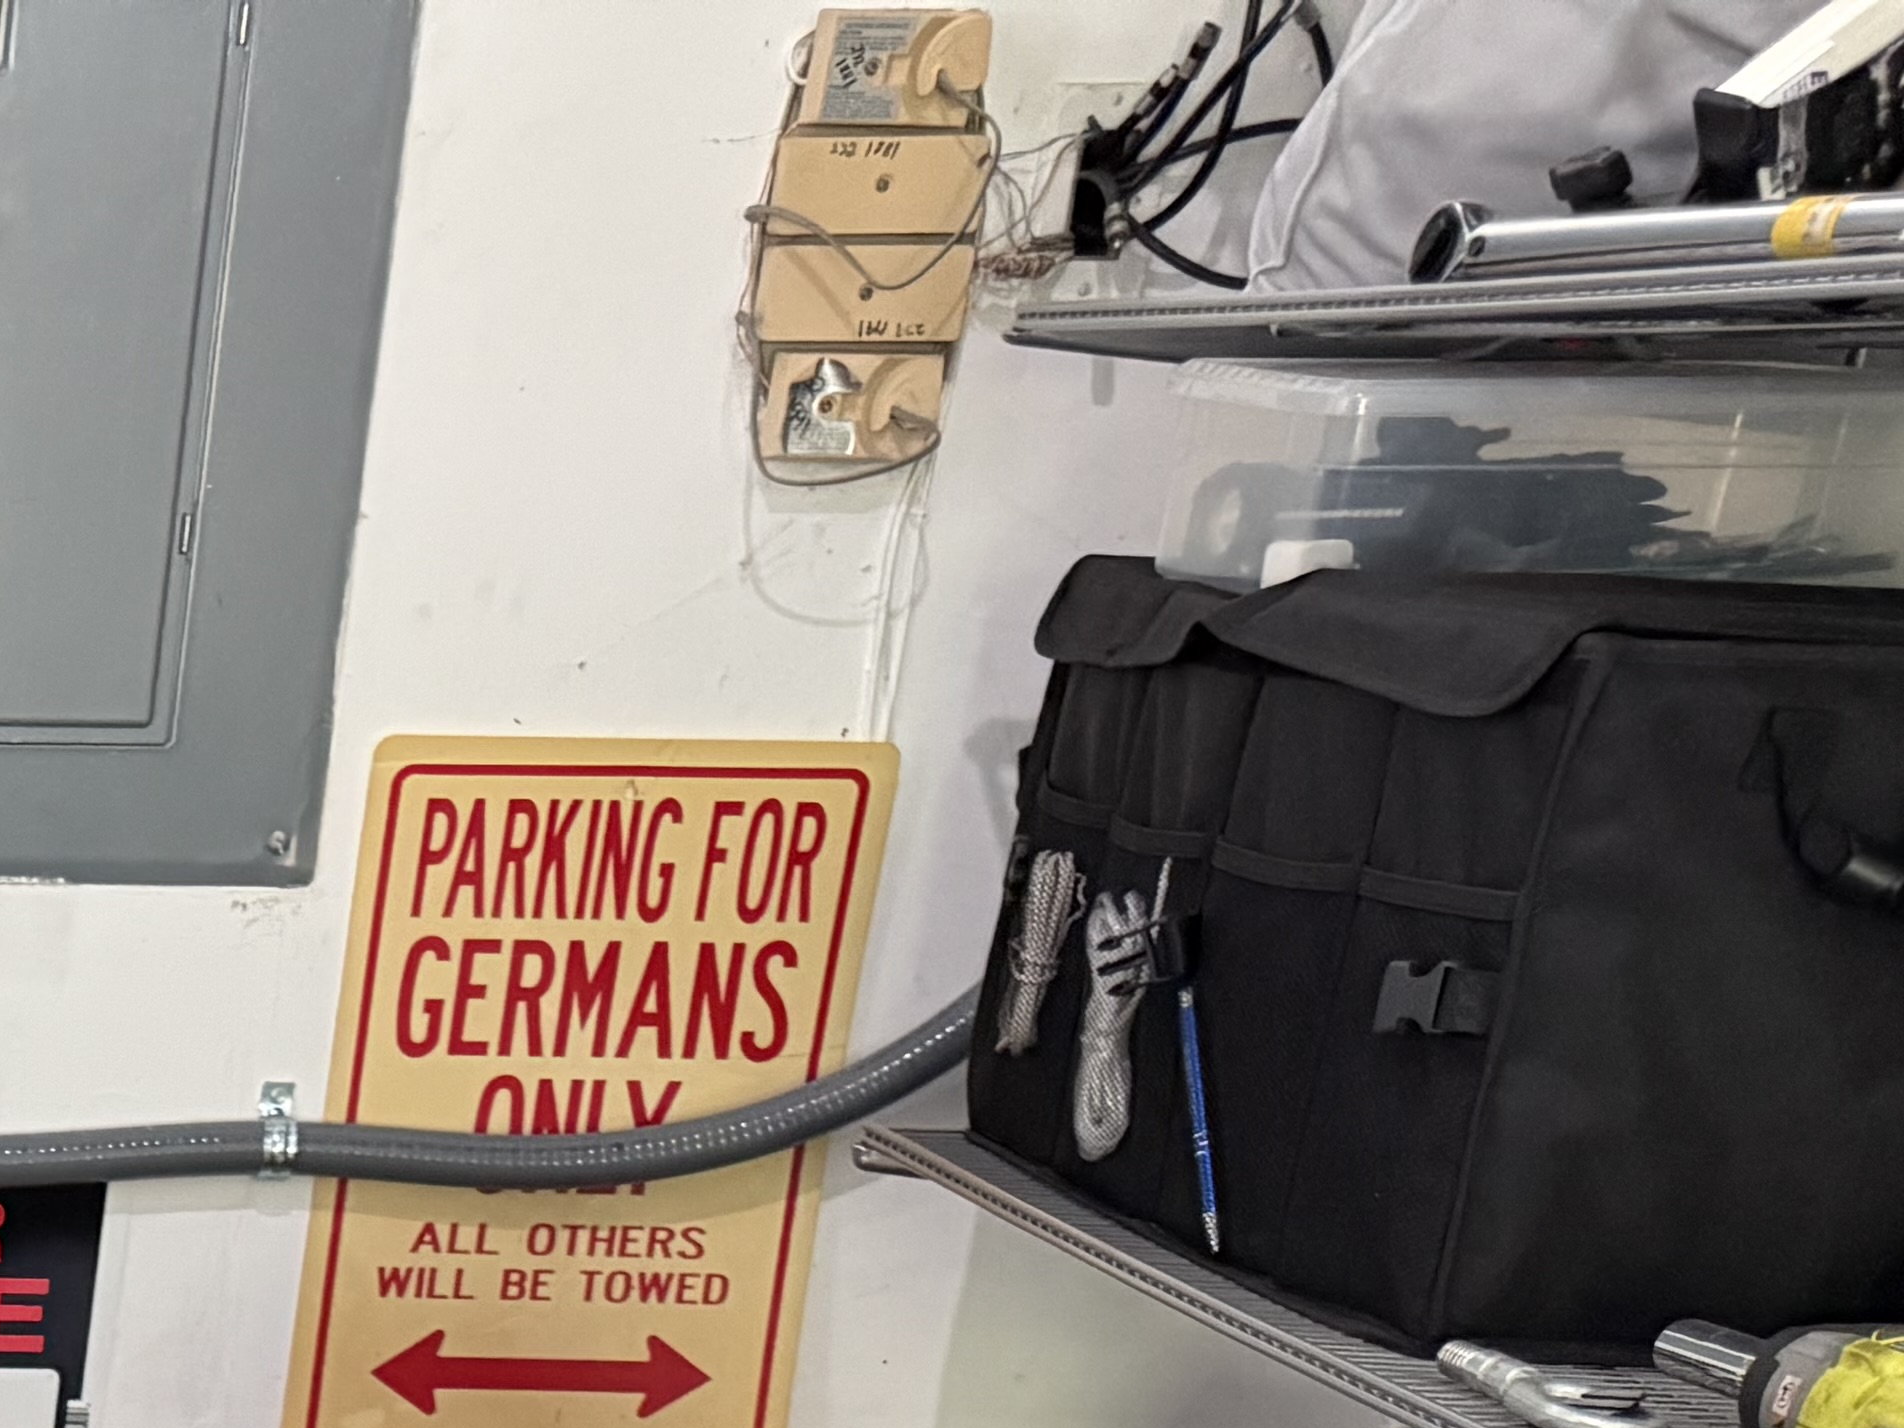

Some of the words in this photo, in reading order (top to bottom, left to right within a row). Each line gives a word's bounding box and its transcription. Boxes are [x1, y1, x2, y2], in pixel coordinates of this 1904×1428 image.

[410, 798, 683, 923] PARKING
[695, 798, 827, 923] FOR
[396, 936, 798, 1063] GERMANS
[410, 1222, 498, 1257] ALL
[527, 1224, 705, 1260] OTHERS
[376, 1266, 475, 1302] WILL
[500, 1269, 551, 1303] BE
[582, 1271, 730, 1306] TOWED
